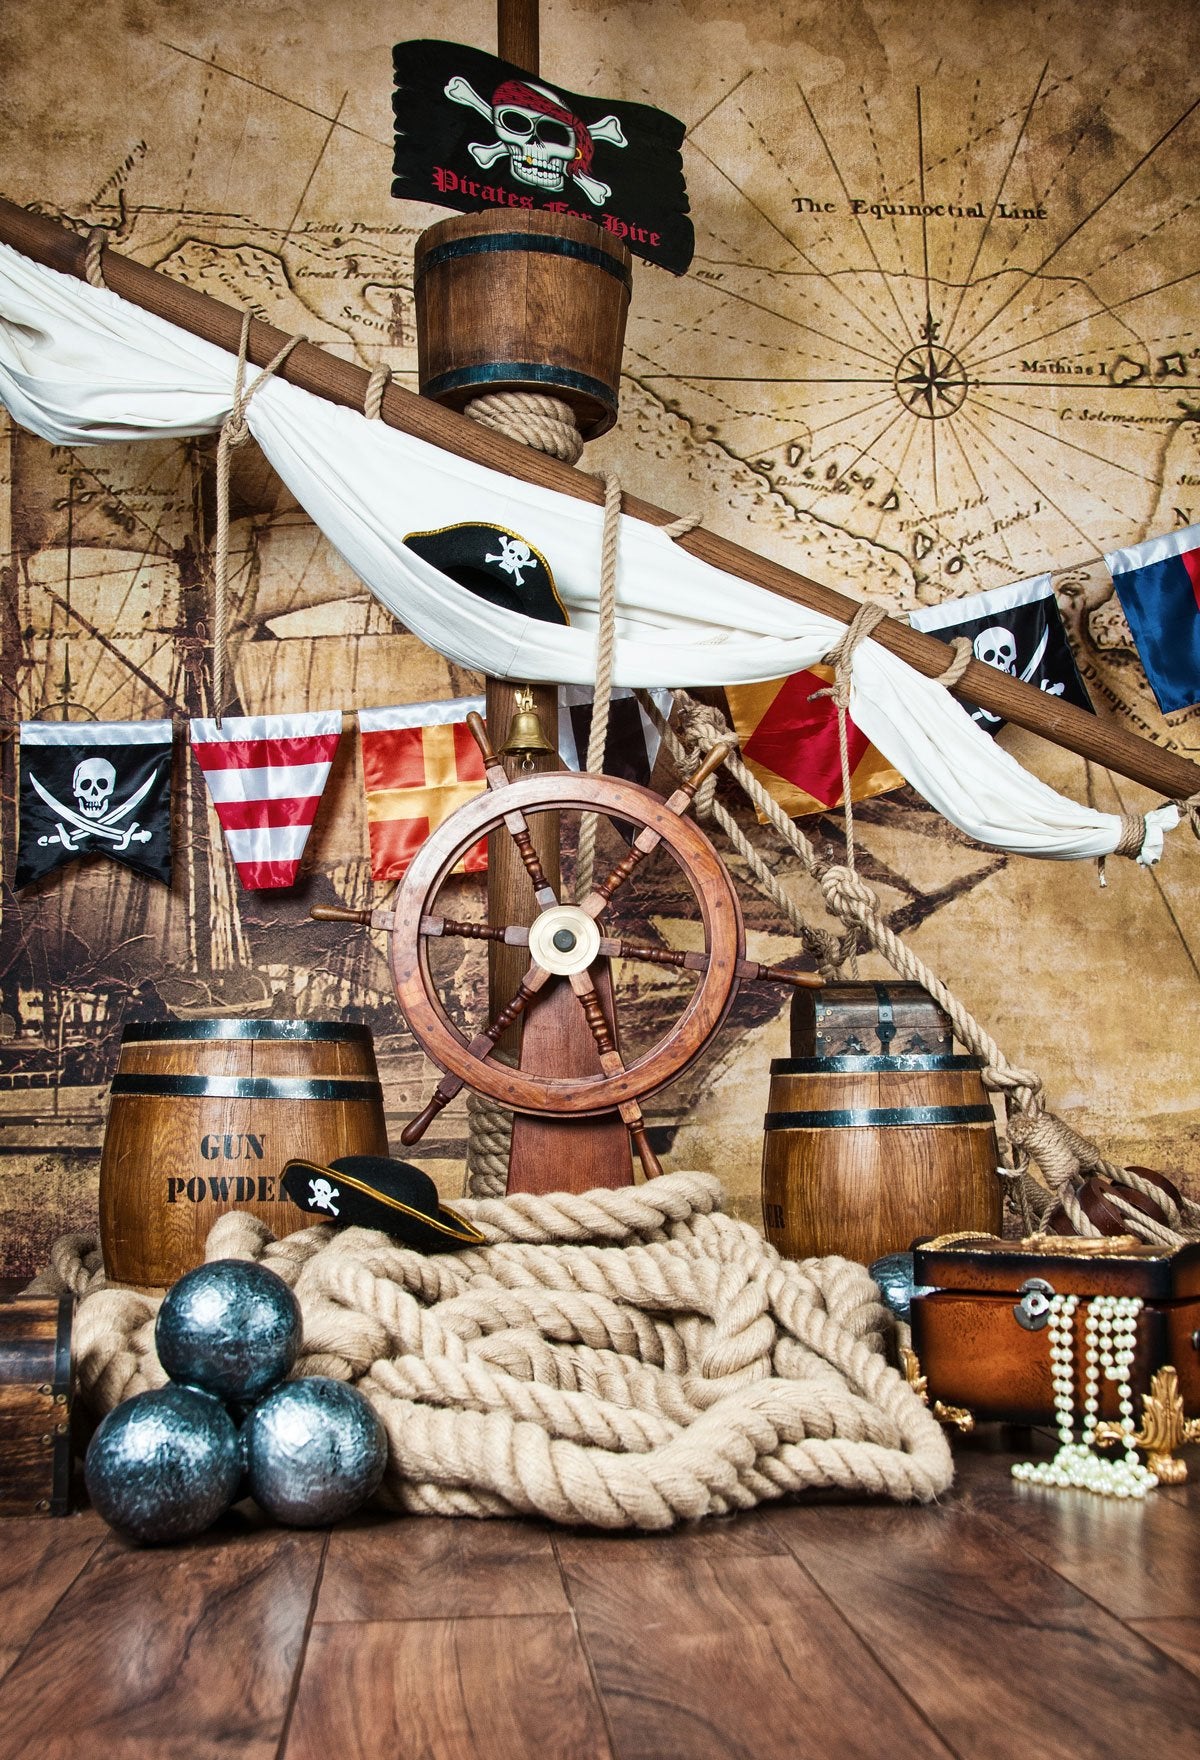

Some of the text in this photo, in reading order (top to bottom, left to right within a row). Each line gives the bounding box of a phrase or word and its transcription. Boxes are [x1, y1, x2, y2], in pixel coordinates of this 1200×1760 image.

[432, 166, 535, 210] Pirates
[601, 213, 662, 247] Hire
[792, 197, 1047, 220] The Equinoctial Line
[1021, 359, 1094, 376] Mathias
[201, 1134, 267, 1160] GUN
